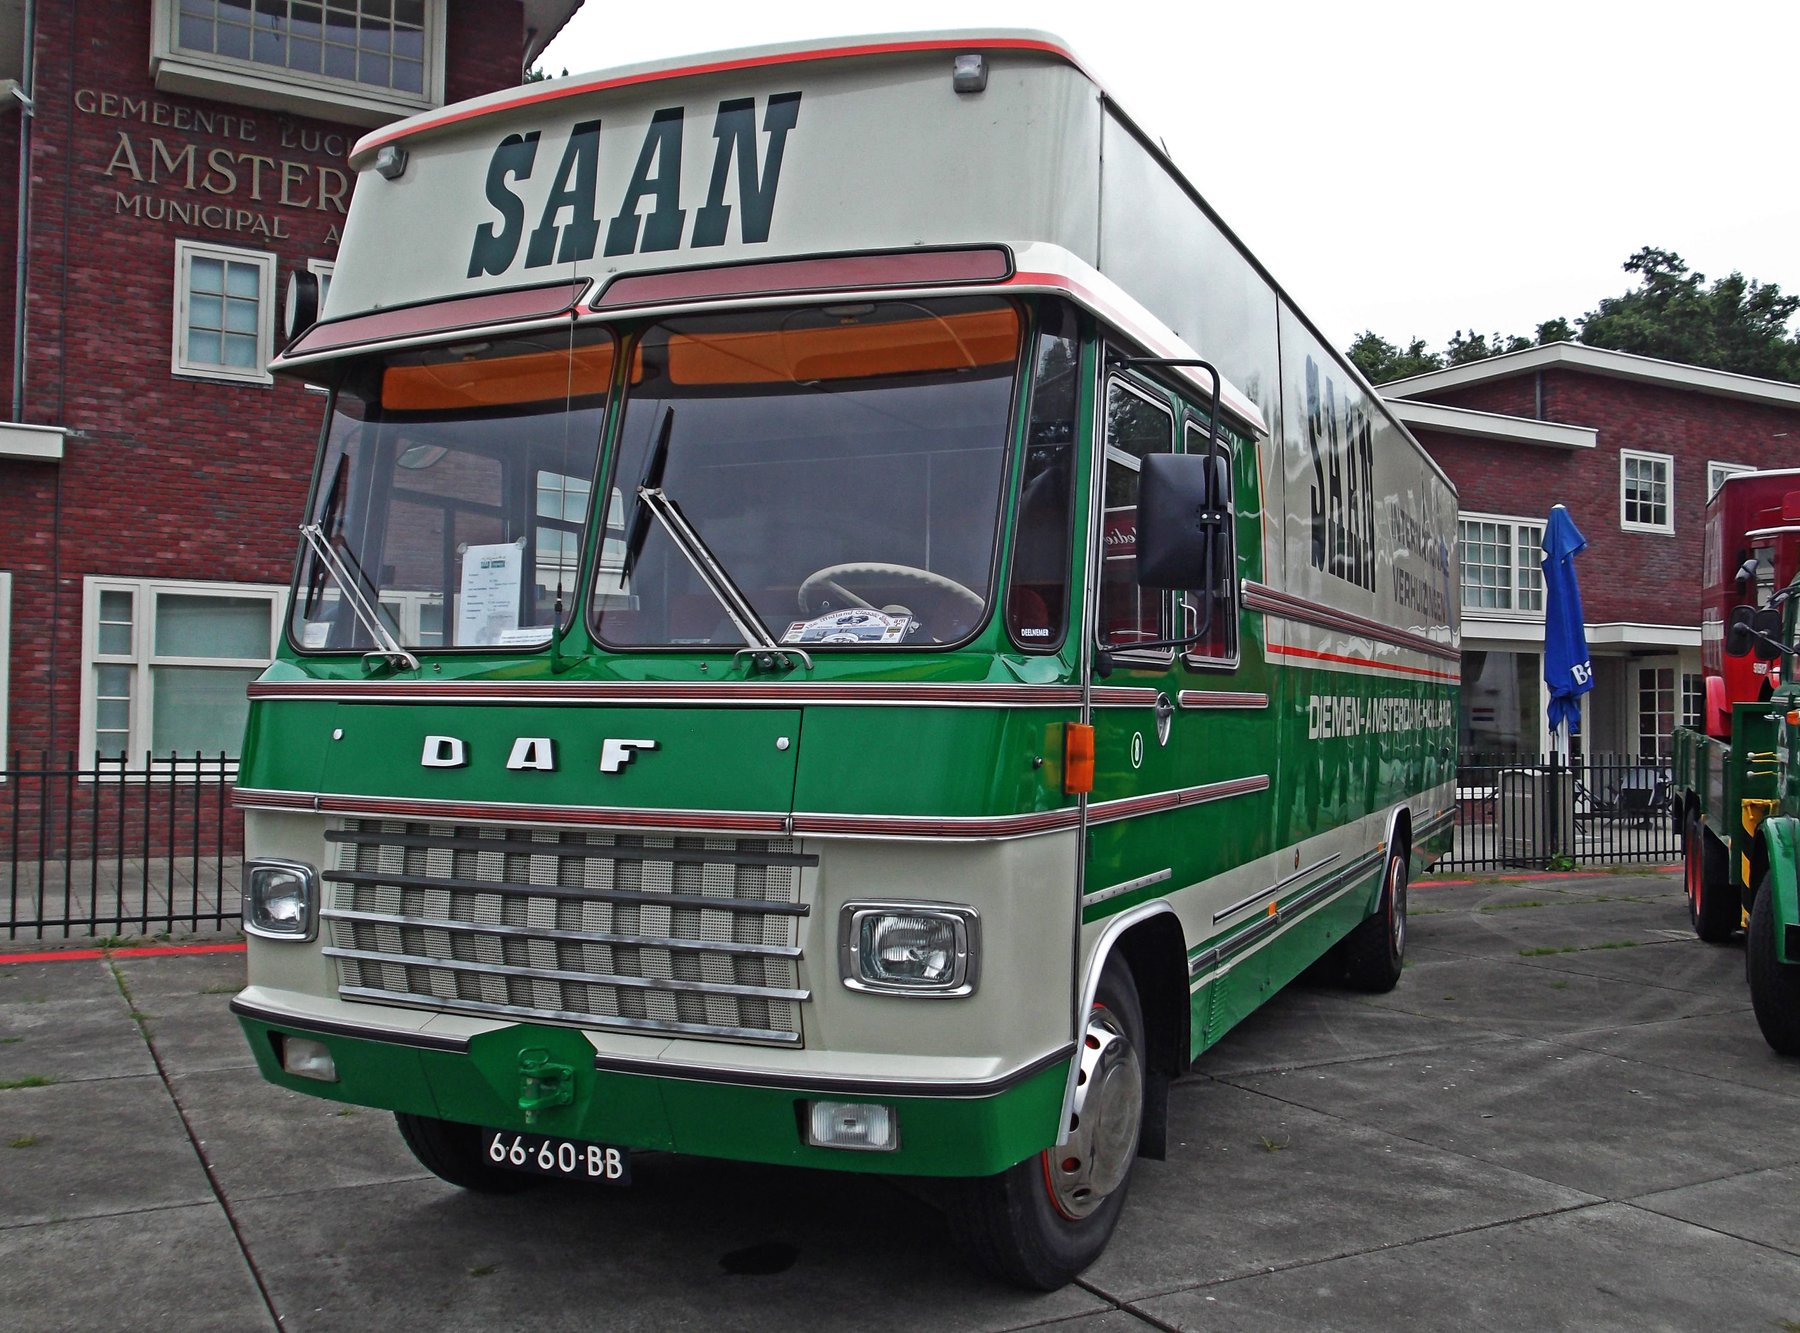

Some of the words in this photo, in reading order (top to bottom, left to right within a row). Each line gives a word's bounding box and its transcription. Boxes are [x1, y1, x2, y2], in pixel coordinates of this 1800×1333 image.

[74, 88, 256, 142] GEMEENTE
[103, 131, 348, 215] AMSTER
[466, 90, 802, 279] SAAN
[115, 191, 290, 240] MUNICIPAL
[1306, 353, 1376, 594] SAAN
[1021, 628, 1049, 637] DEELNEMER
[421, 735, 656, 772] DAF
[489, 1132, 623, 1179] 66-60-BB
